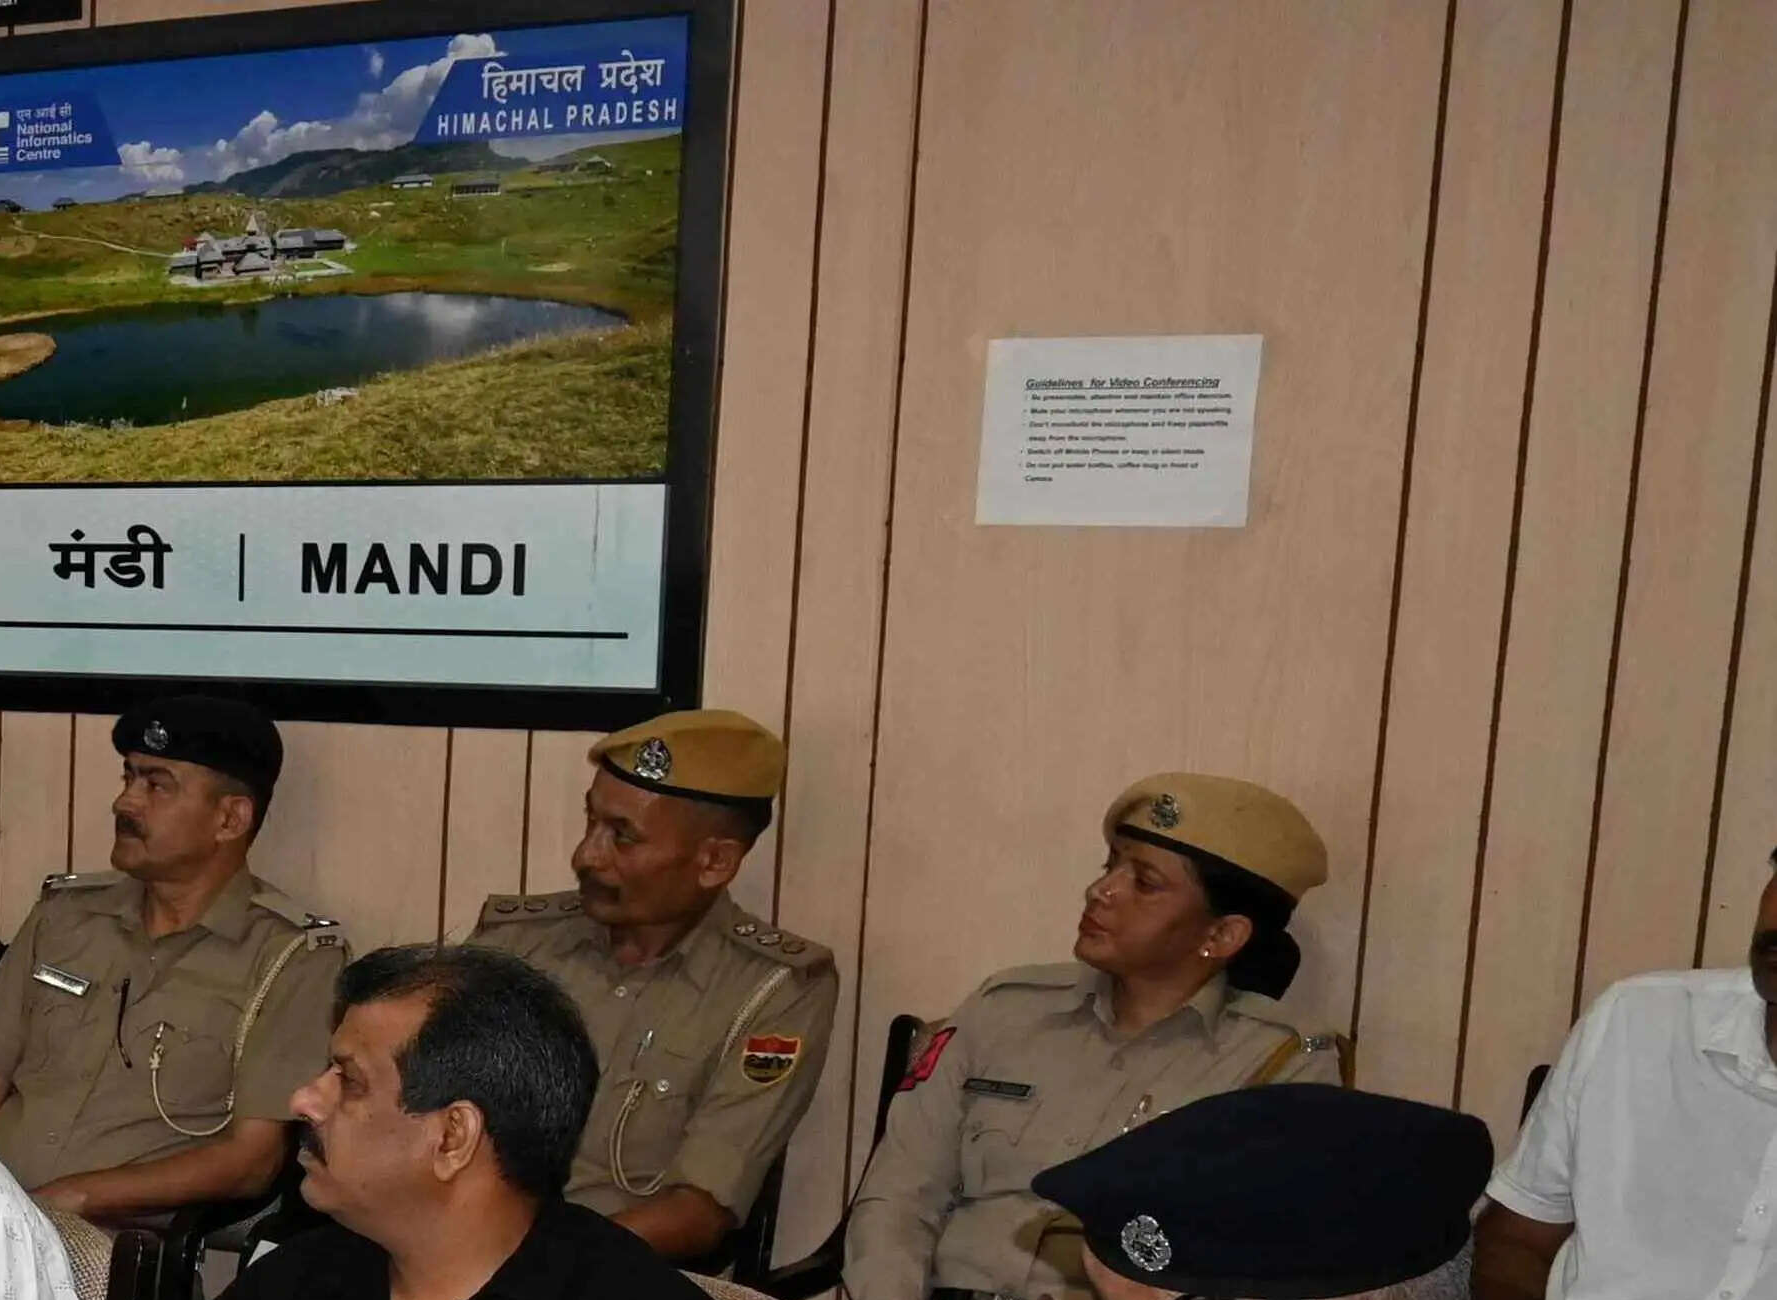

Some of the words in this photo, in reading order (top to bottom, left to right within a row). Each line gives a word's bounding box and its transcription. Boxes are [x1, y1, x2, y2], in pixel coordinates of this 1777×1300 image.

[481, 61, 586, 104] हिमाचल
[598, 50, 665, 94] प्रदेश
[16, 120, 72, 136] National
[437, 107, 554, 136] HIMACHAL
[566, 98, 677, 127] PRADESH
[16, 131, 93, 148] Informatics
[16, 147, 61, 161] Centre
[1025, 378, 1083, 389] Guidelines
[1090, 377, 1106, 388] for
[1109, 377, 1140, 388] Video
[1144, 376, 1221, 388] Conferencing
[48, 524, 173, 589] मंडी
[301, 542, 527, 596] MANDI
